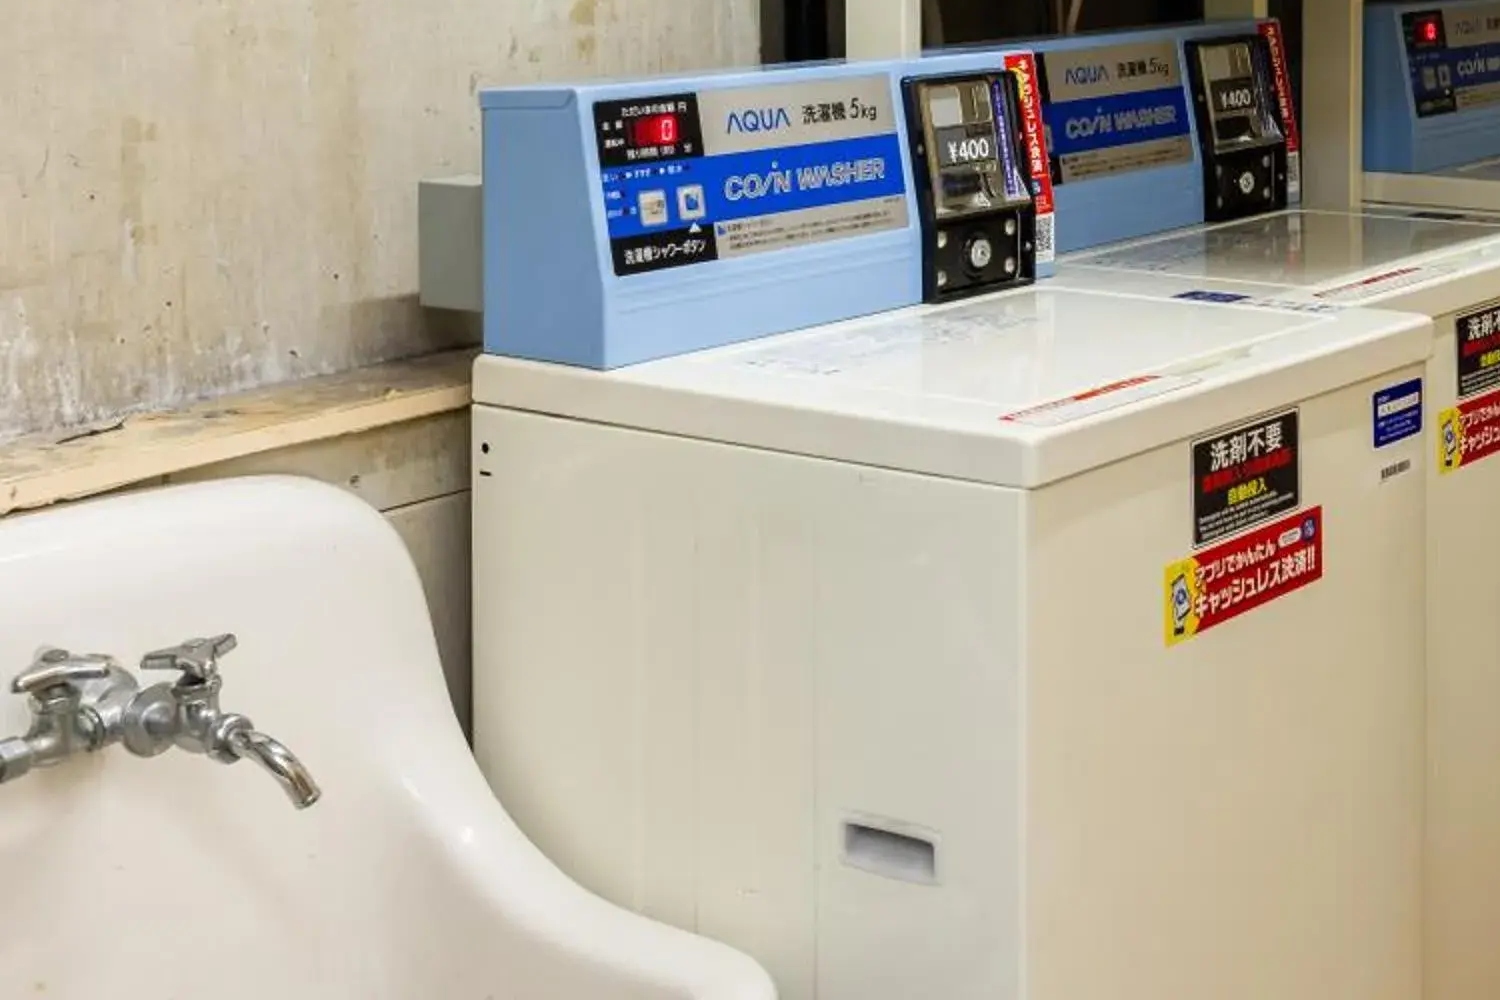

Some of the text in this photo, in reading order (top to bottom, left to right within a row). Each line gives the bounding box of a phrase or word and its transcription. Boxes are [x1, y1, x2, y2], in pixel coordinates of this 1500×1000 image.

[1065, 64, 1109, 86] AQUA
[661, 119, 673, 141] 0
[727, 97, 877, 134] AQUA 洗濯機 5kg
[947, 138, 990, 164] ¥400
[795, 157, 885, 191] WASHER
[1211, 421, 1284, 471] 洗剤不要
[1196, 539, 1276, 587] アプリでかんたん
